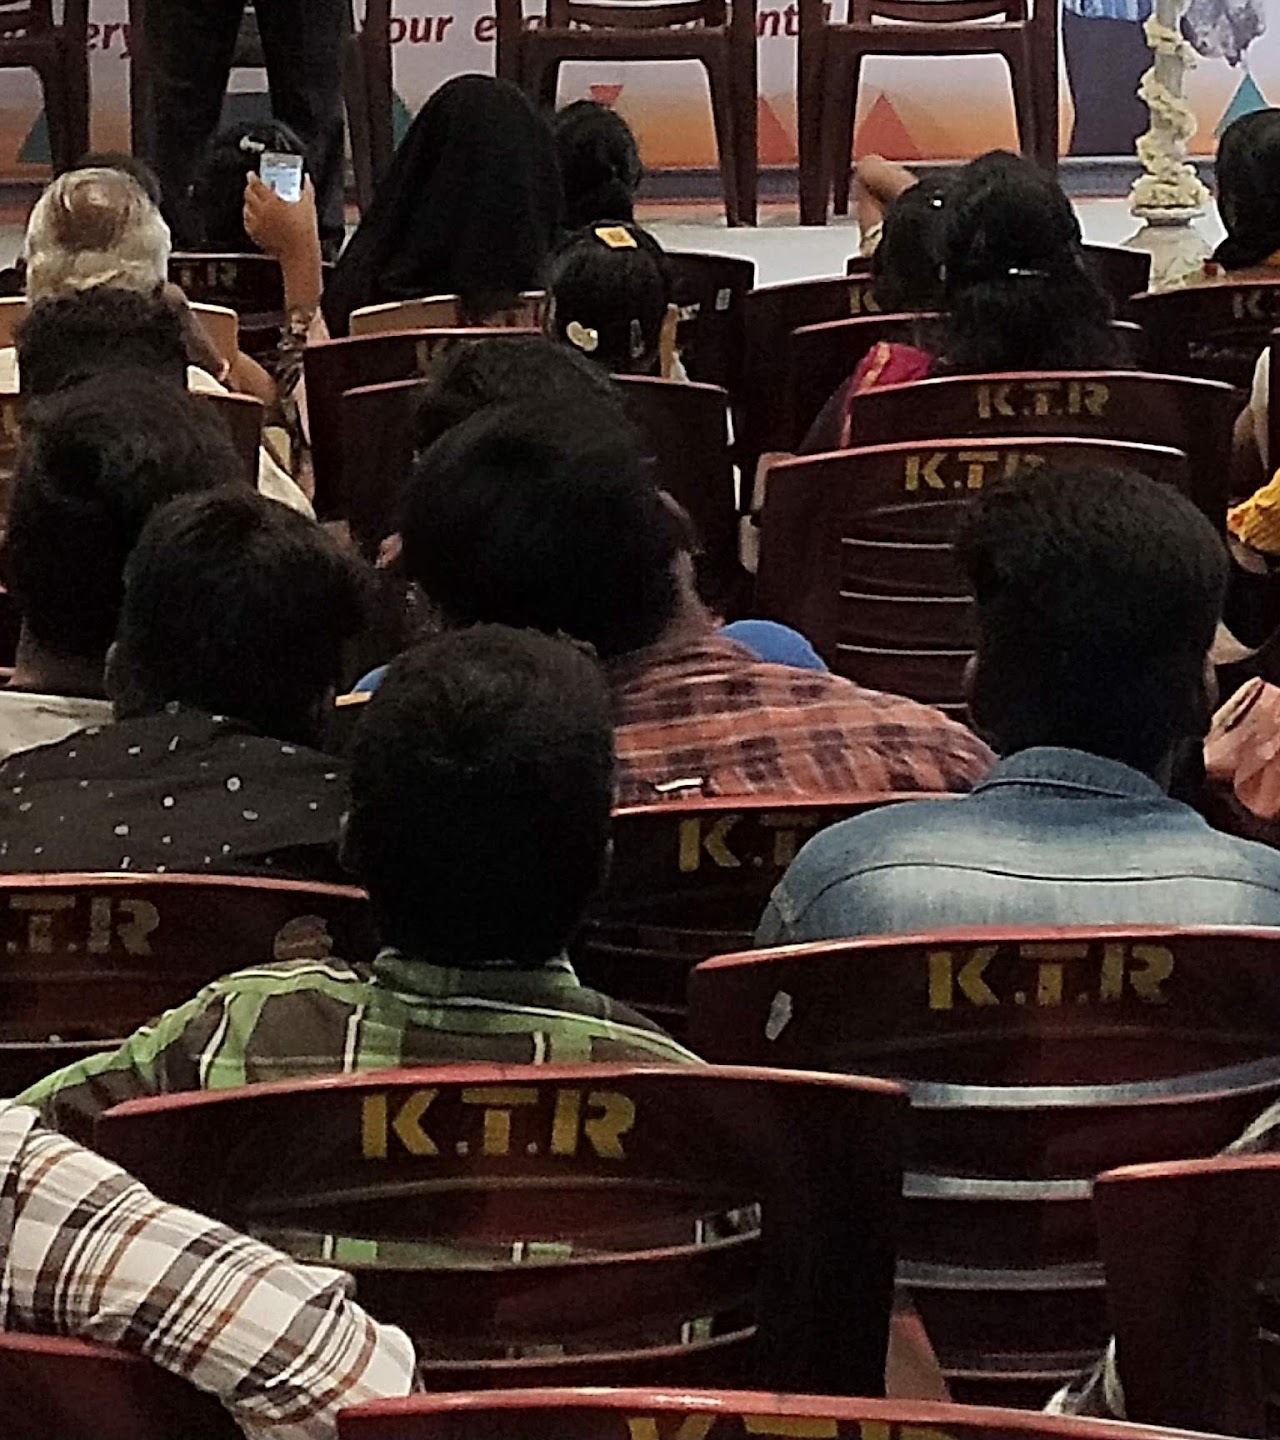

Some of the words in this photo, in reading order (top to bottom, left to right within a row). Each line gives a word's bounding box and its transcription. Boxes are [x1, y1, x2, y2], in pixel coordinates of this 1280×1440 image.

[390, 15, 454, 44] our
[976, 380, 1111, 420] K.T.R
[677, 812, 819, 873] K.T
[926, 942, 1175, 1011] K.T.R
[360, 1086, 638, 1160] K.T.R
